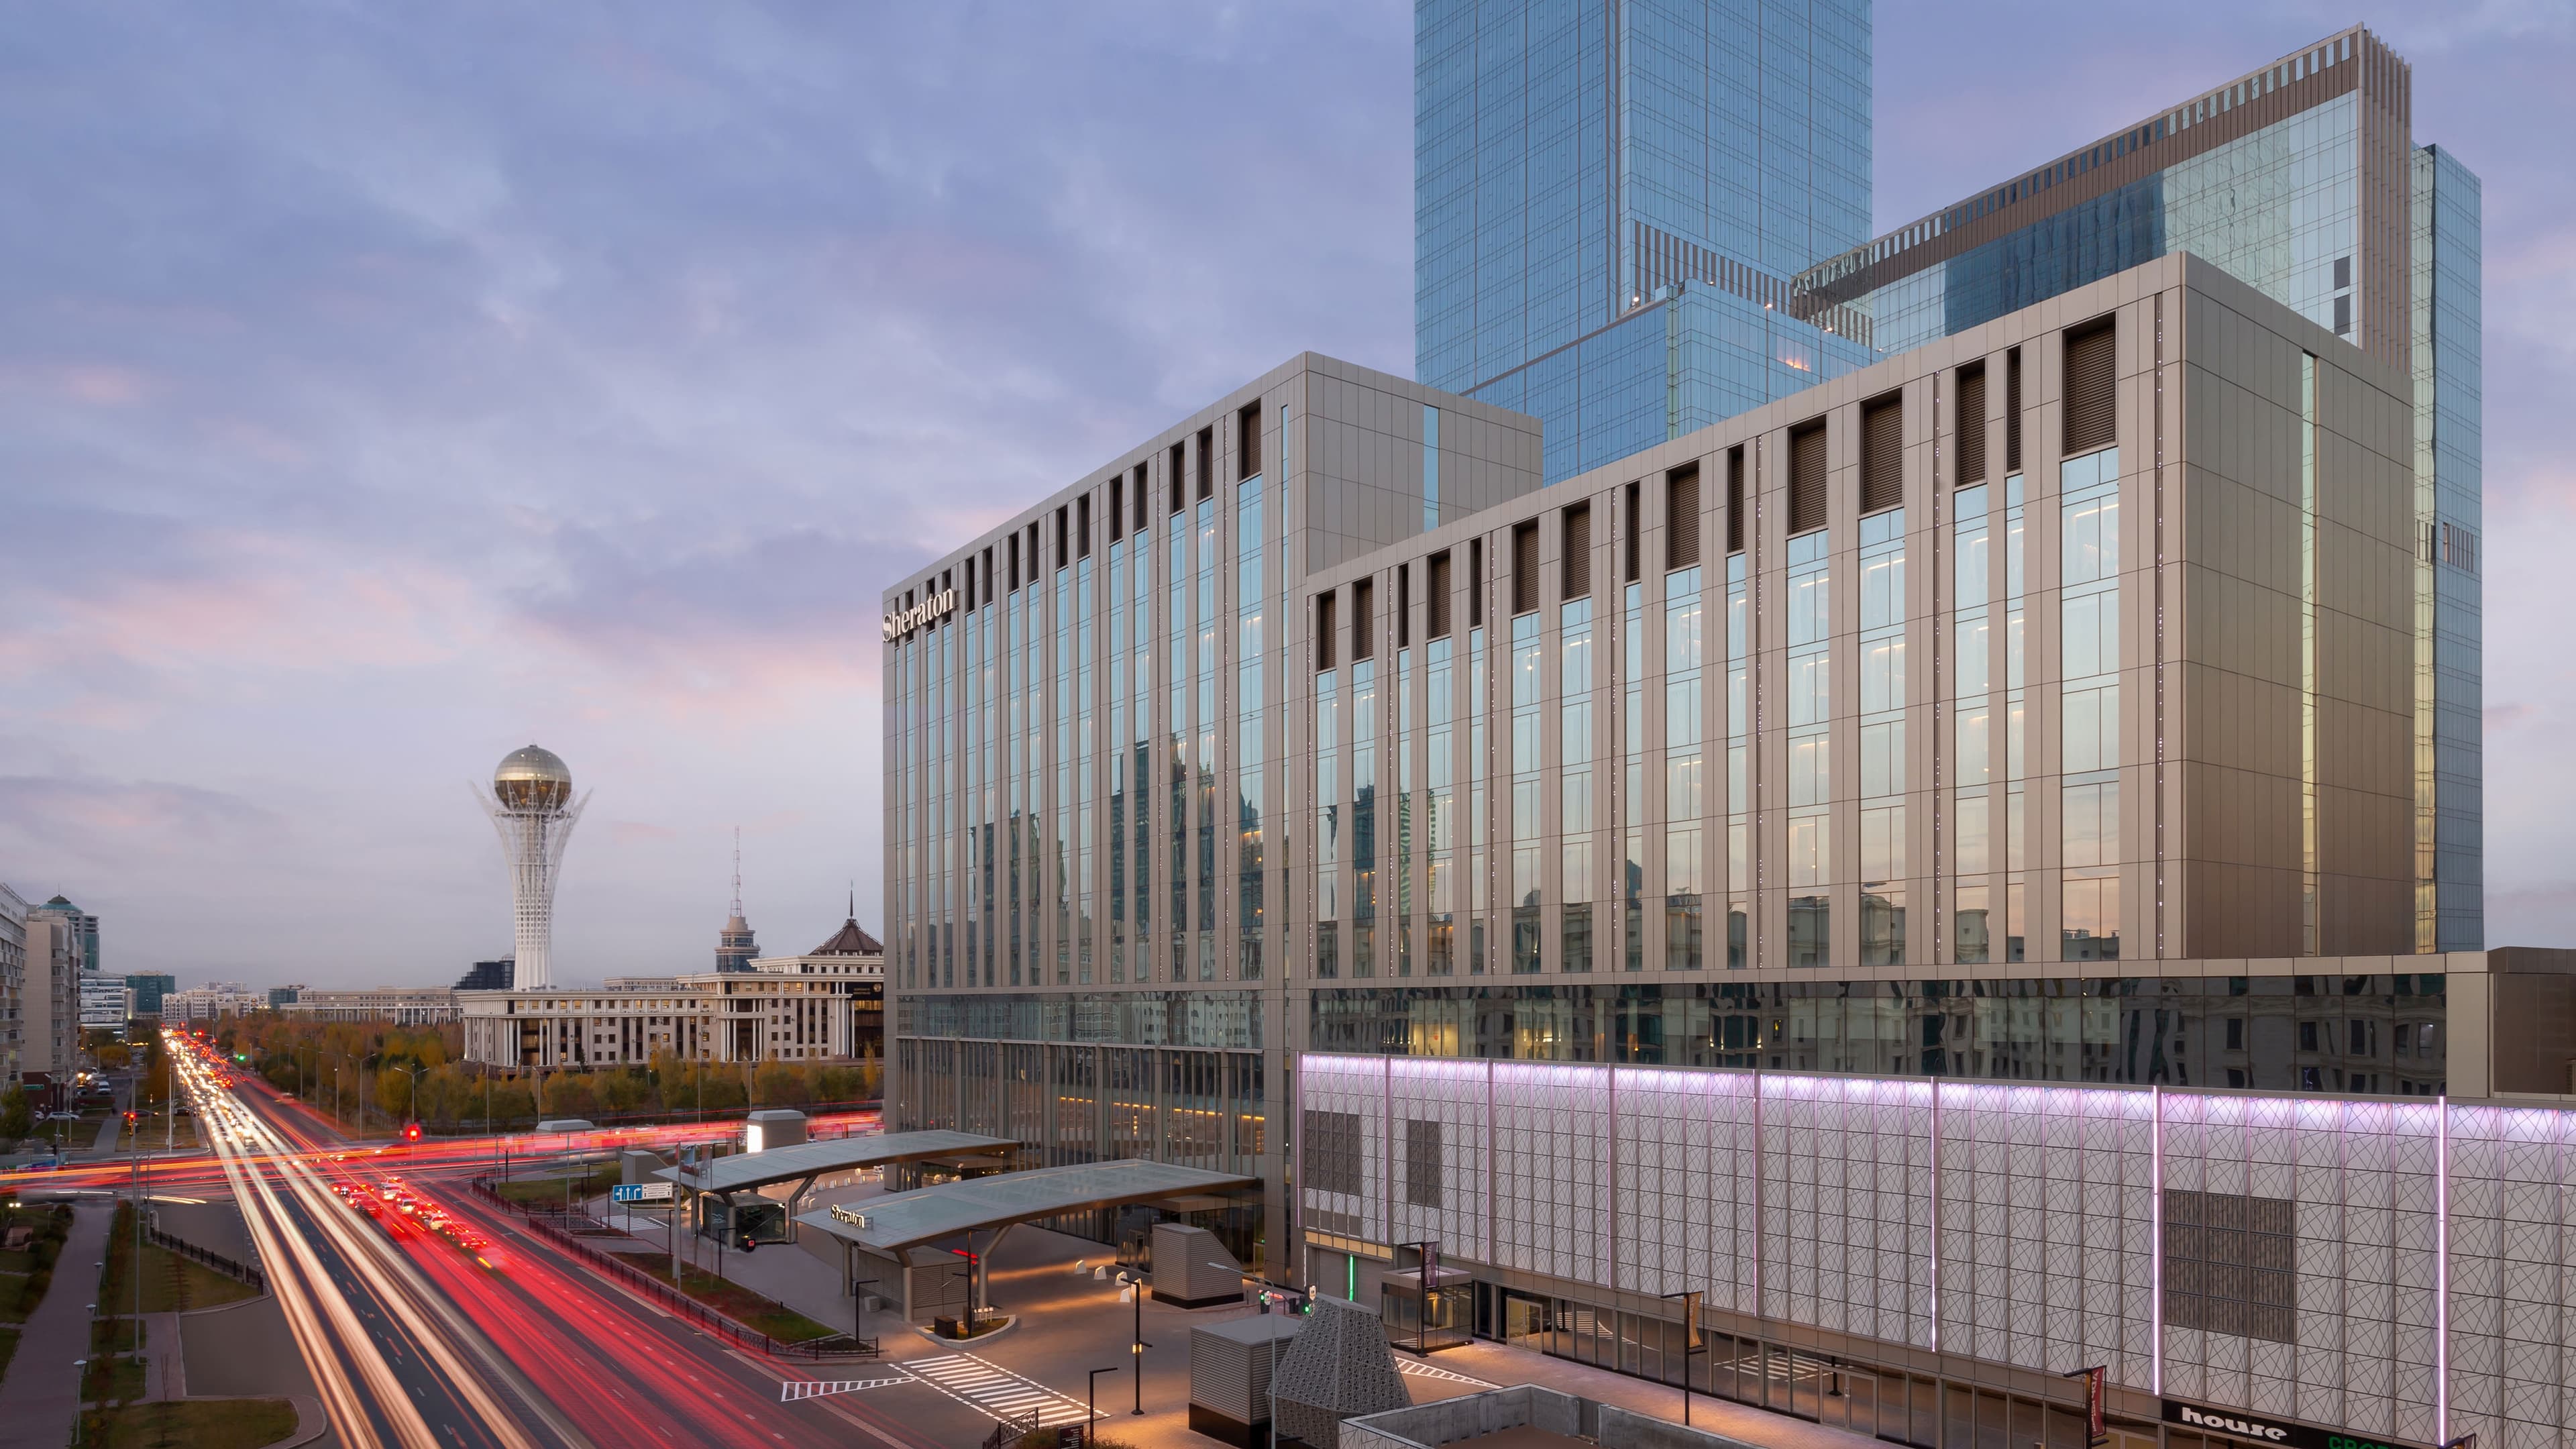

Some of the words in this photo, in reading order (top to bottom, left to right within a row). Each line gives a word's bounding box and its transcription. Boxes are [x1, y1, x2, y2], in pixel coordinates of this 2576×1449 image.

[882, 588, 954, 642] Sheraton
[831, 1204, 864, 1229] Sheraton
[2182, 1407, 2288, 1440] house
